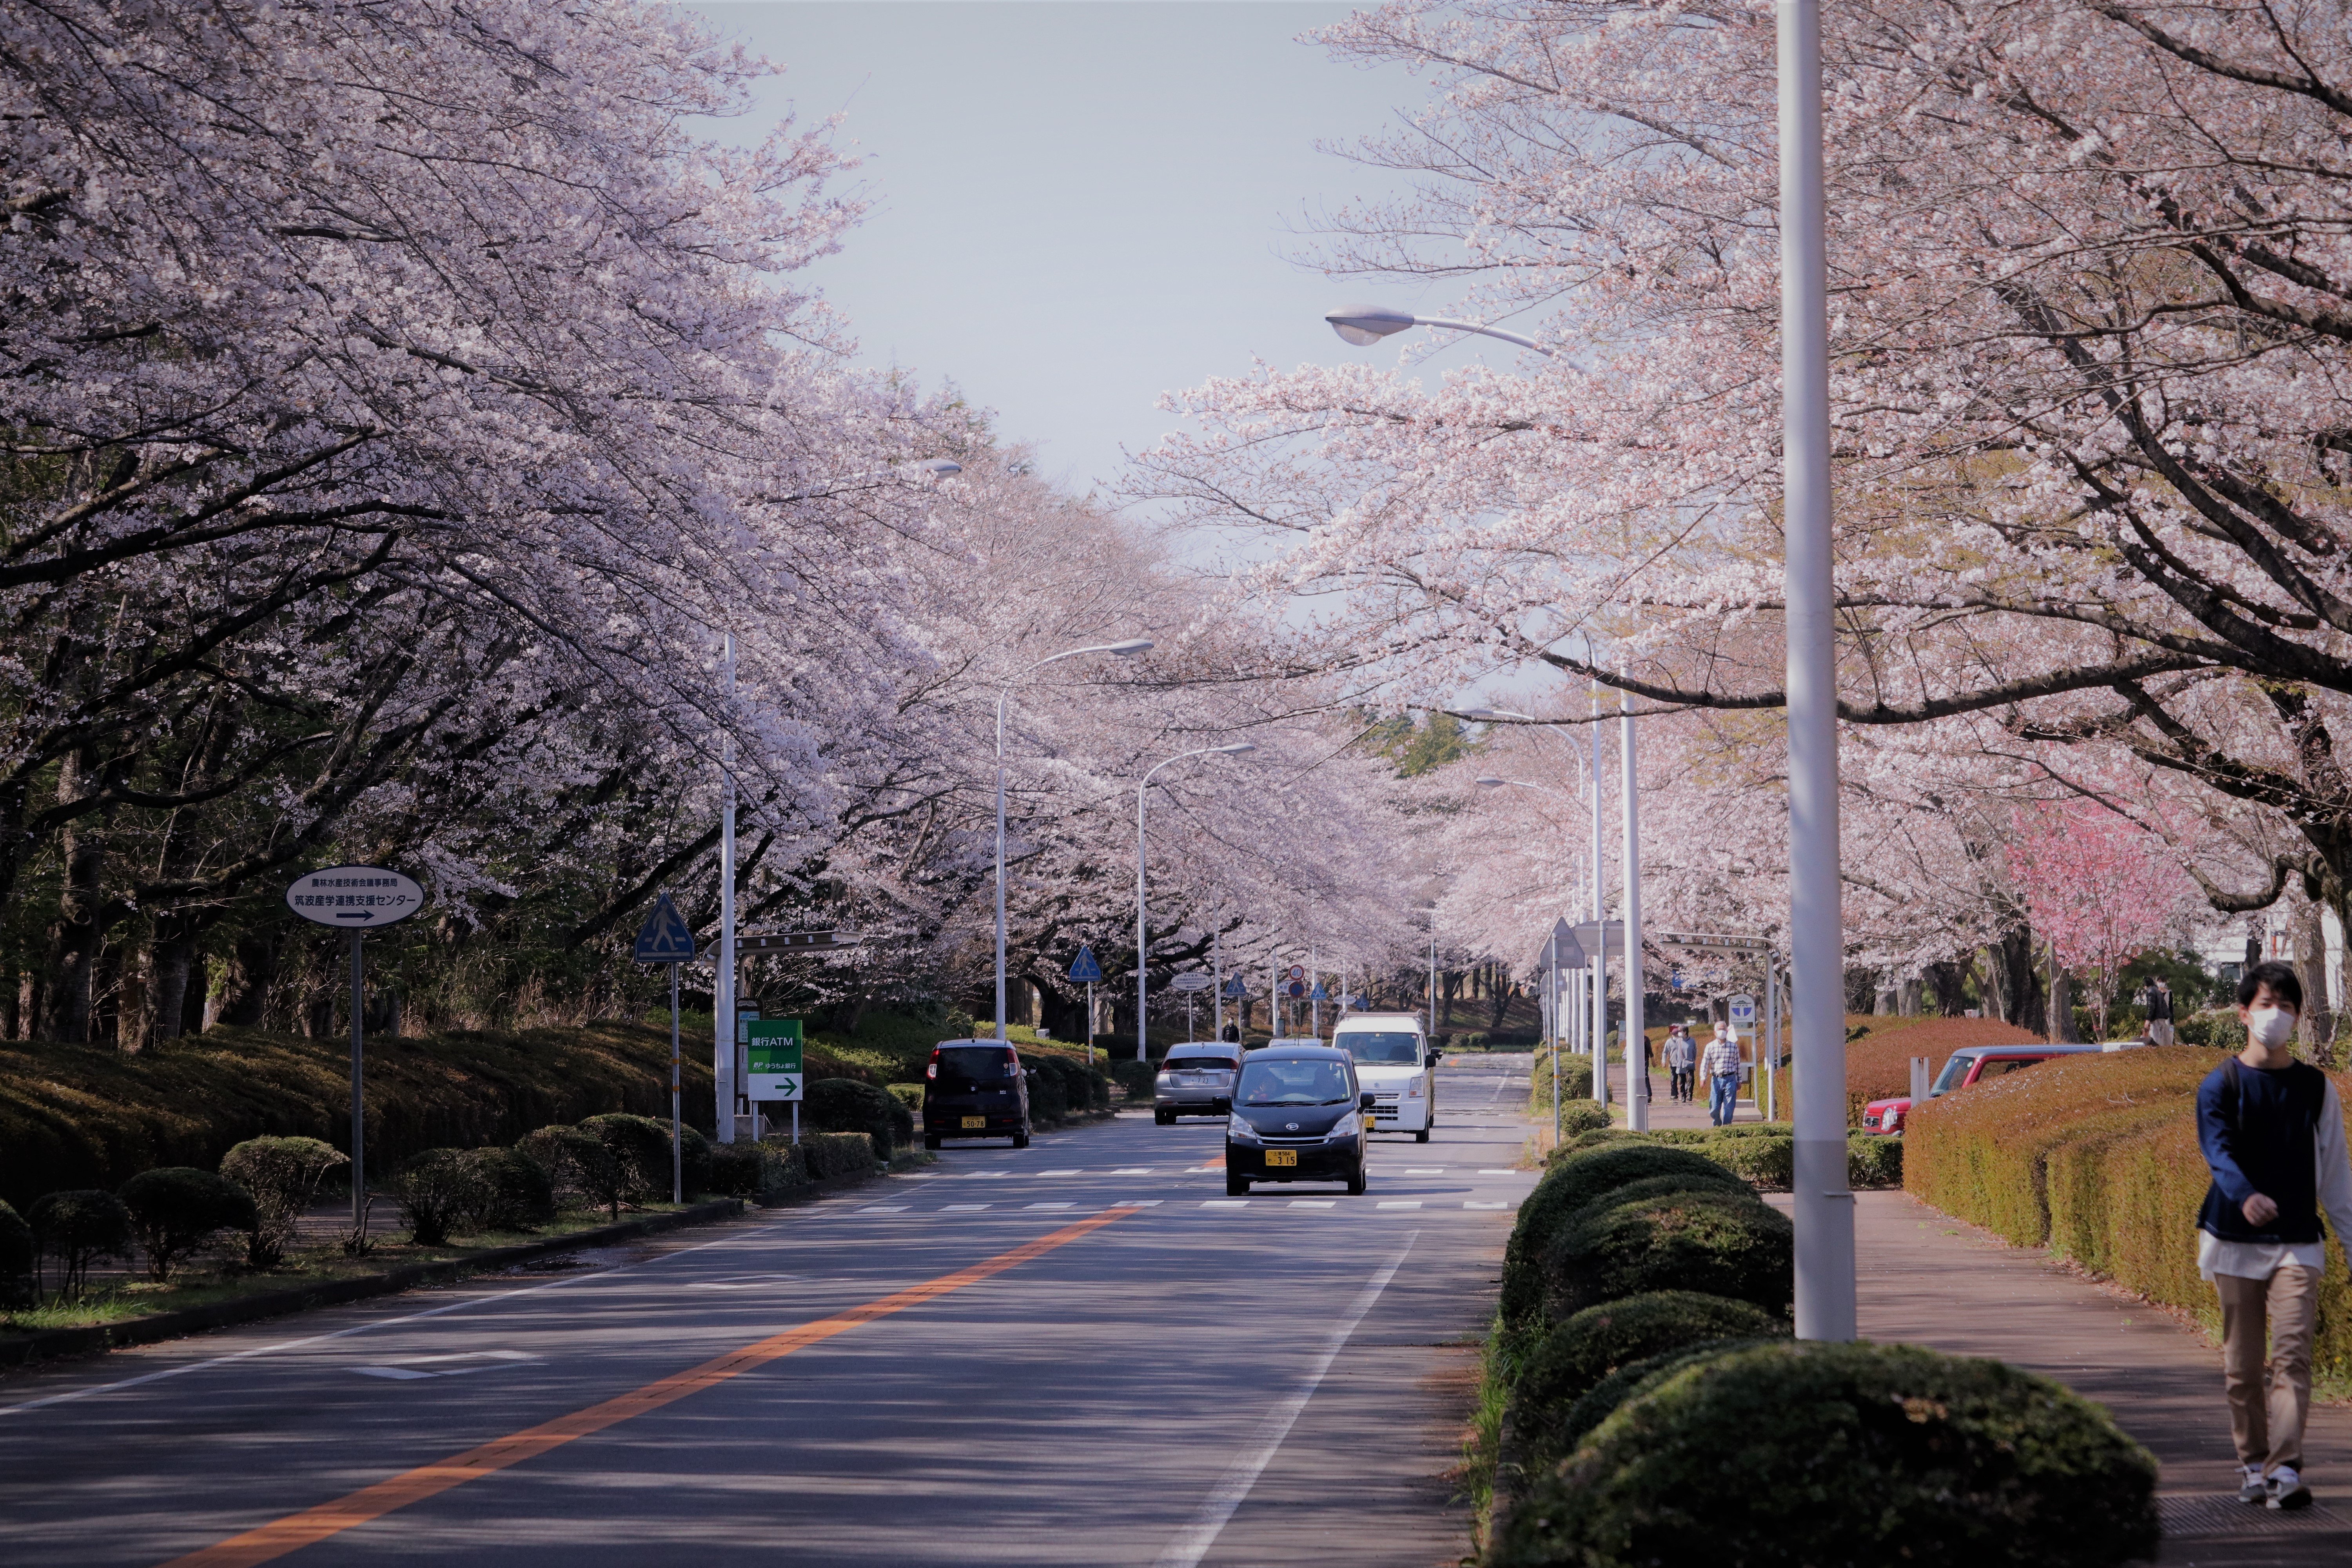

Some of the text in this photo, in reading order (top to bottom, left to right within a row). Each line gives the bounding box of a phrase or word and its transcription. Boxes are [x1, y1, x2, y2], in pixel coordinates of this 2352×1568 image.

[312, 878, 397, 887] 農林水産技術会議事務局
[295, 895, 416, 906] 筑波産学連携支援センター
[751, 1037, 793, 1046] 銀行ATM
